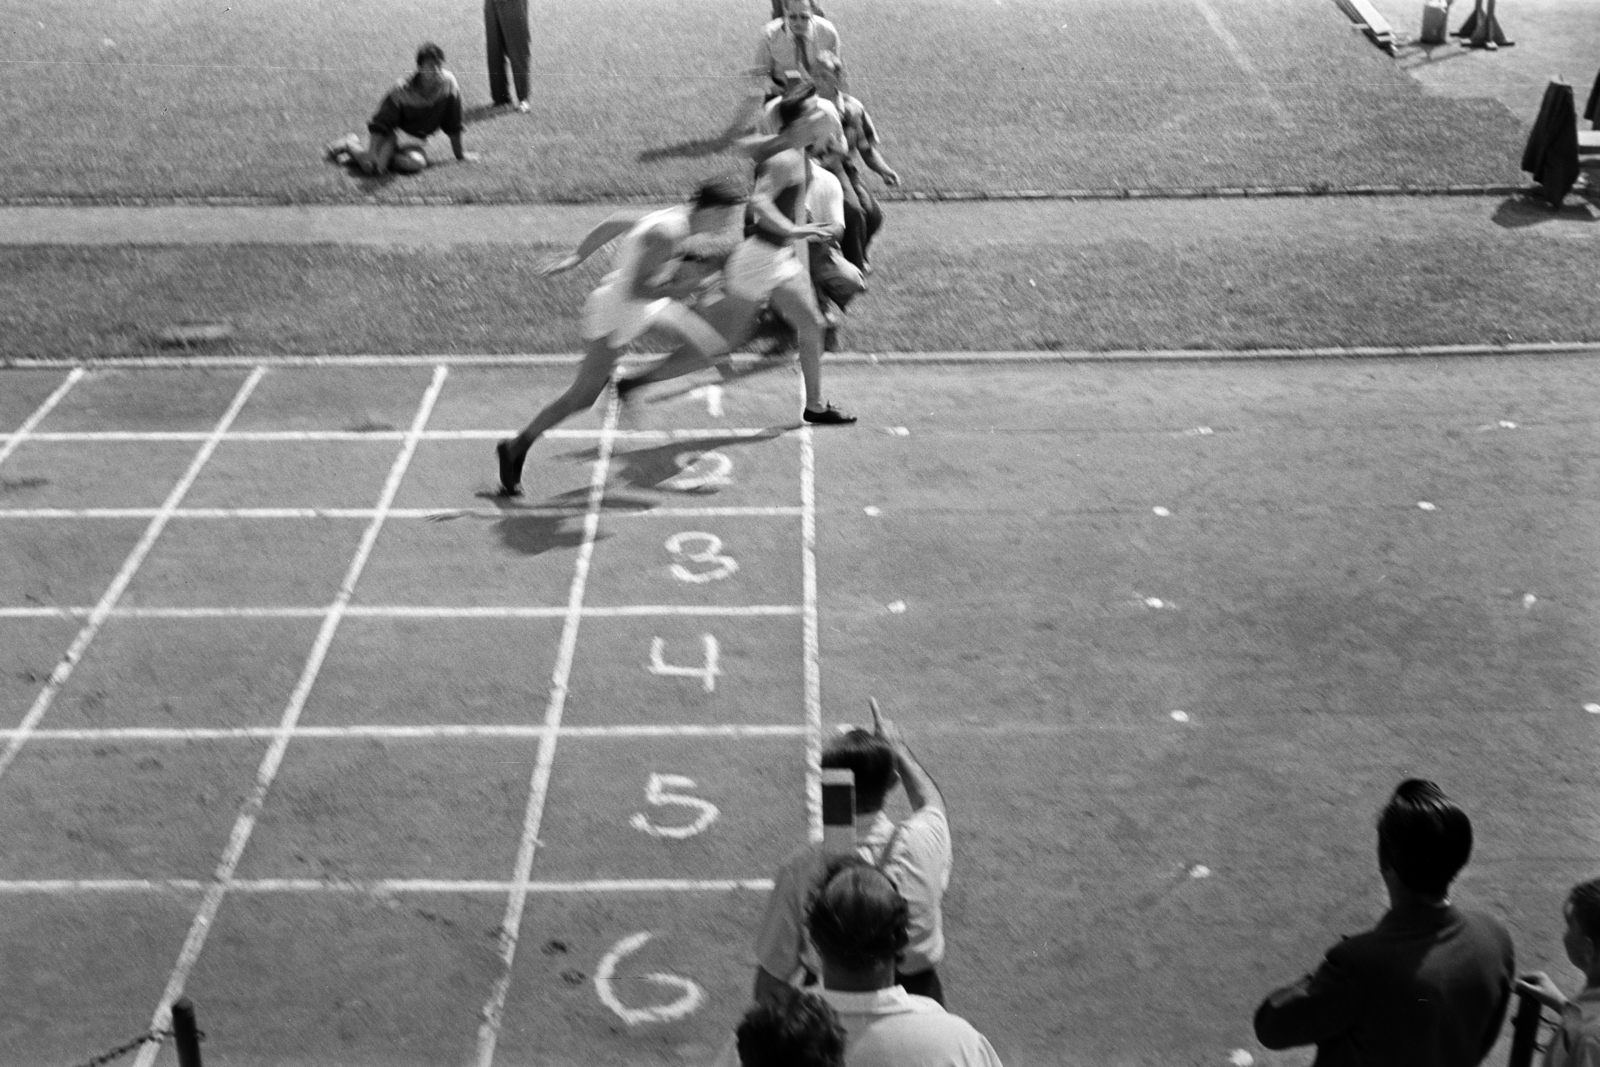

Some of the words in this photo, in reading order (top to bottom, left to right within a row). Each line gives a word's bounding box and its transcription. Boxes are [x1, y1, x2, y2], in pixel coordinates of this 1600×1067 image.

[689, 384, 724, 417] 1
[671, 451, 733, 489] 2
[665, 531, 739, 583] 3
[648, 633, 722, 692] 4
[629, 773, 719, 838] 5
[595, 931, 704, 1024] 6
